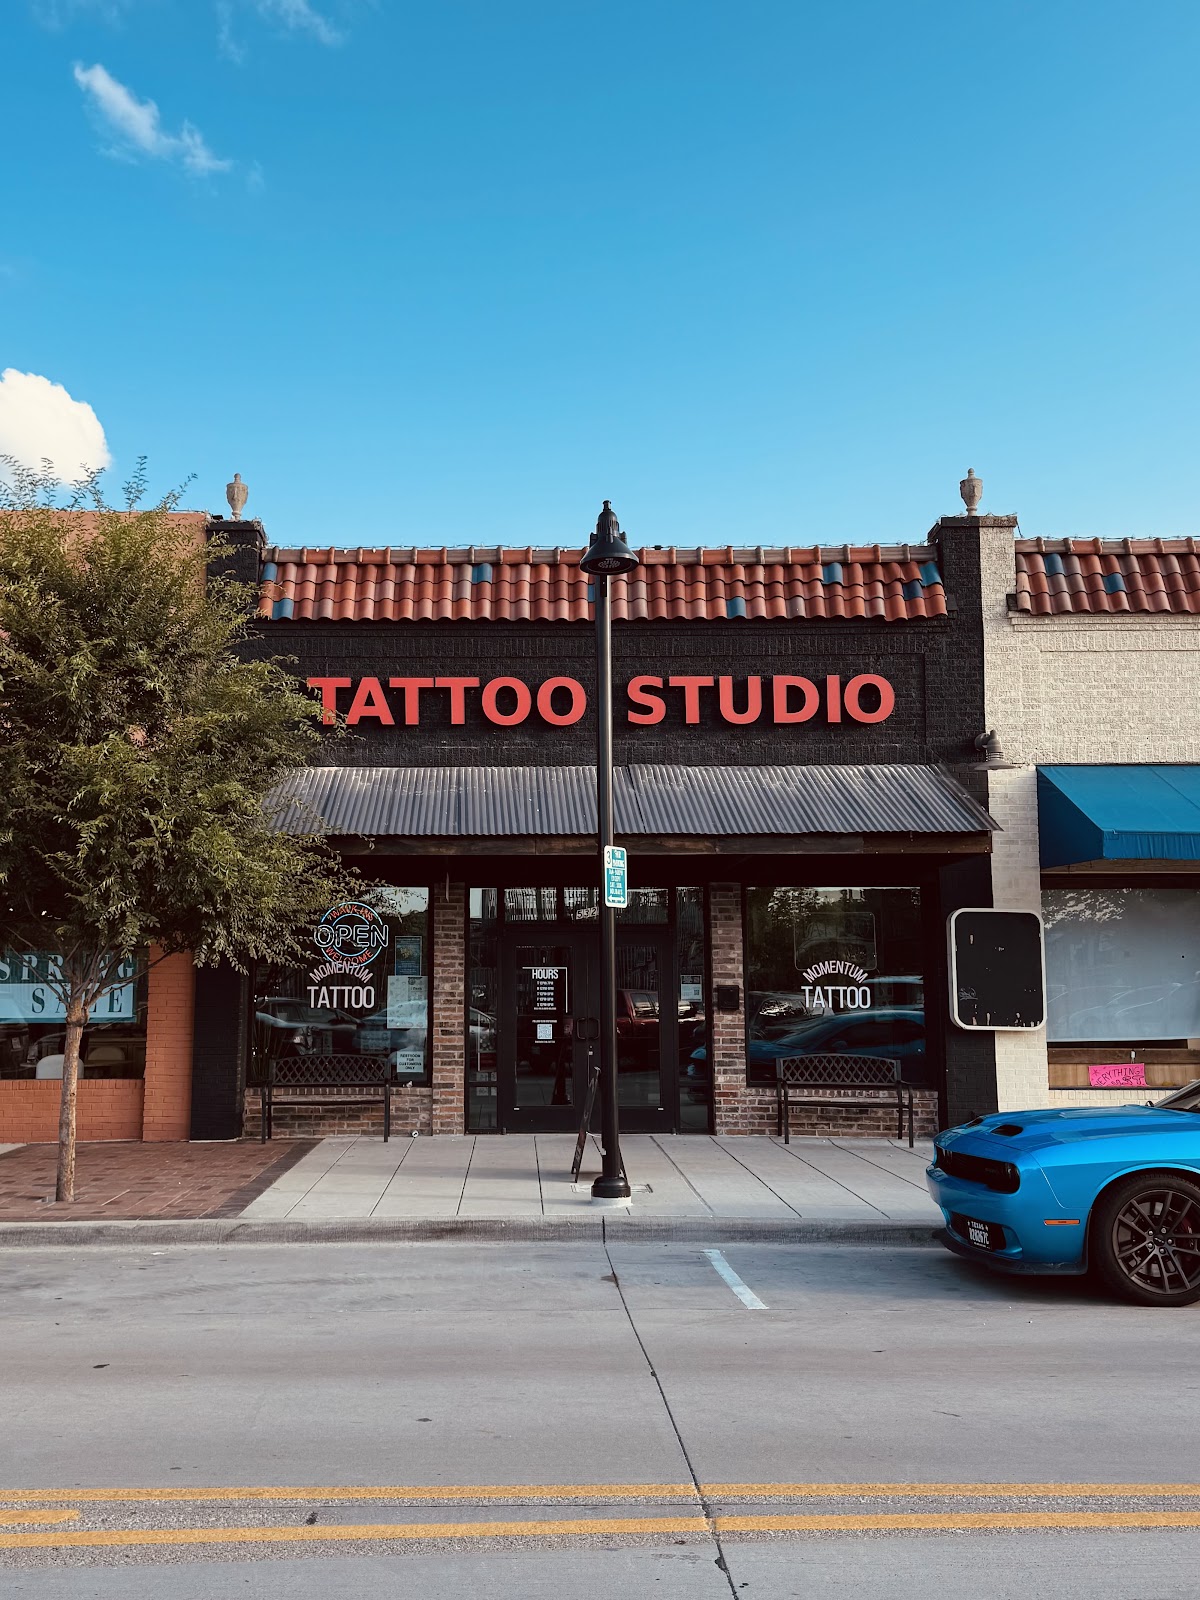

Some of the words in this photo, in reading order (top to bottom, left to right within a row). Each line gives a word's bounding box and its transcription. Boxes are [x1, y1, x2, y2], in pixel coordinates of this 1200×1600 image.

[306, 676, 587, 726] TATTOO
[627, 674, 895, 725] STUDIO
[606, 850, 612, 865] 3
[314, 924, 389, 948] OPEN
[325, 946, 374, 964] WELCOME
[0, 954, 135, 981] SPRNG
[309, 960, 374, 984] MOMENTUM
[531, 969, 559, 980] HOURS
[802, 960, 869, 984] MOMENTUM
[306, 986, 375, 1009] TATTOO
[801, 985, 871, 1009] TATTOO
[1094, 1066, 1141, 1087] VERYTHING
